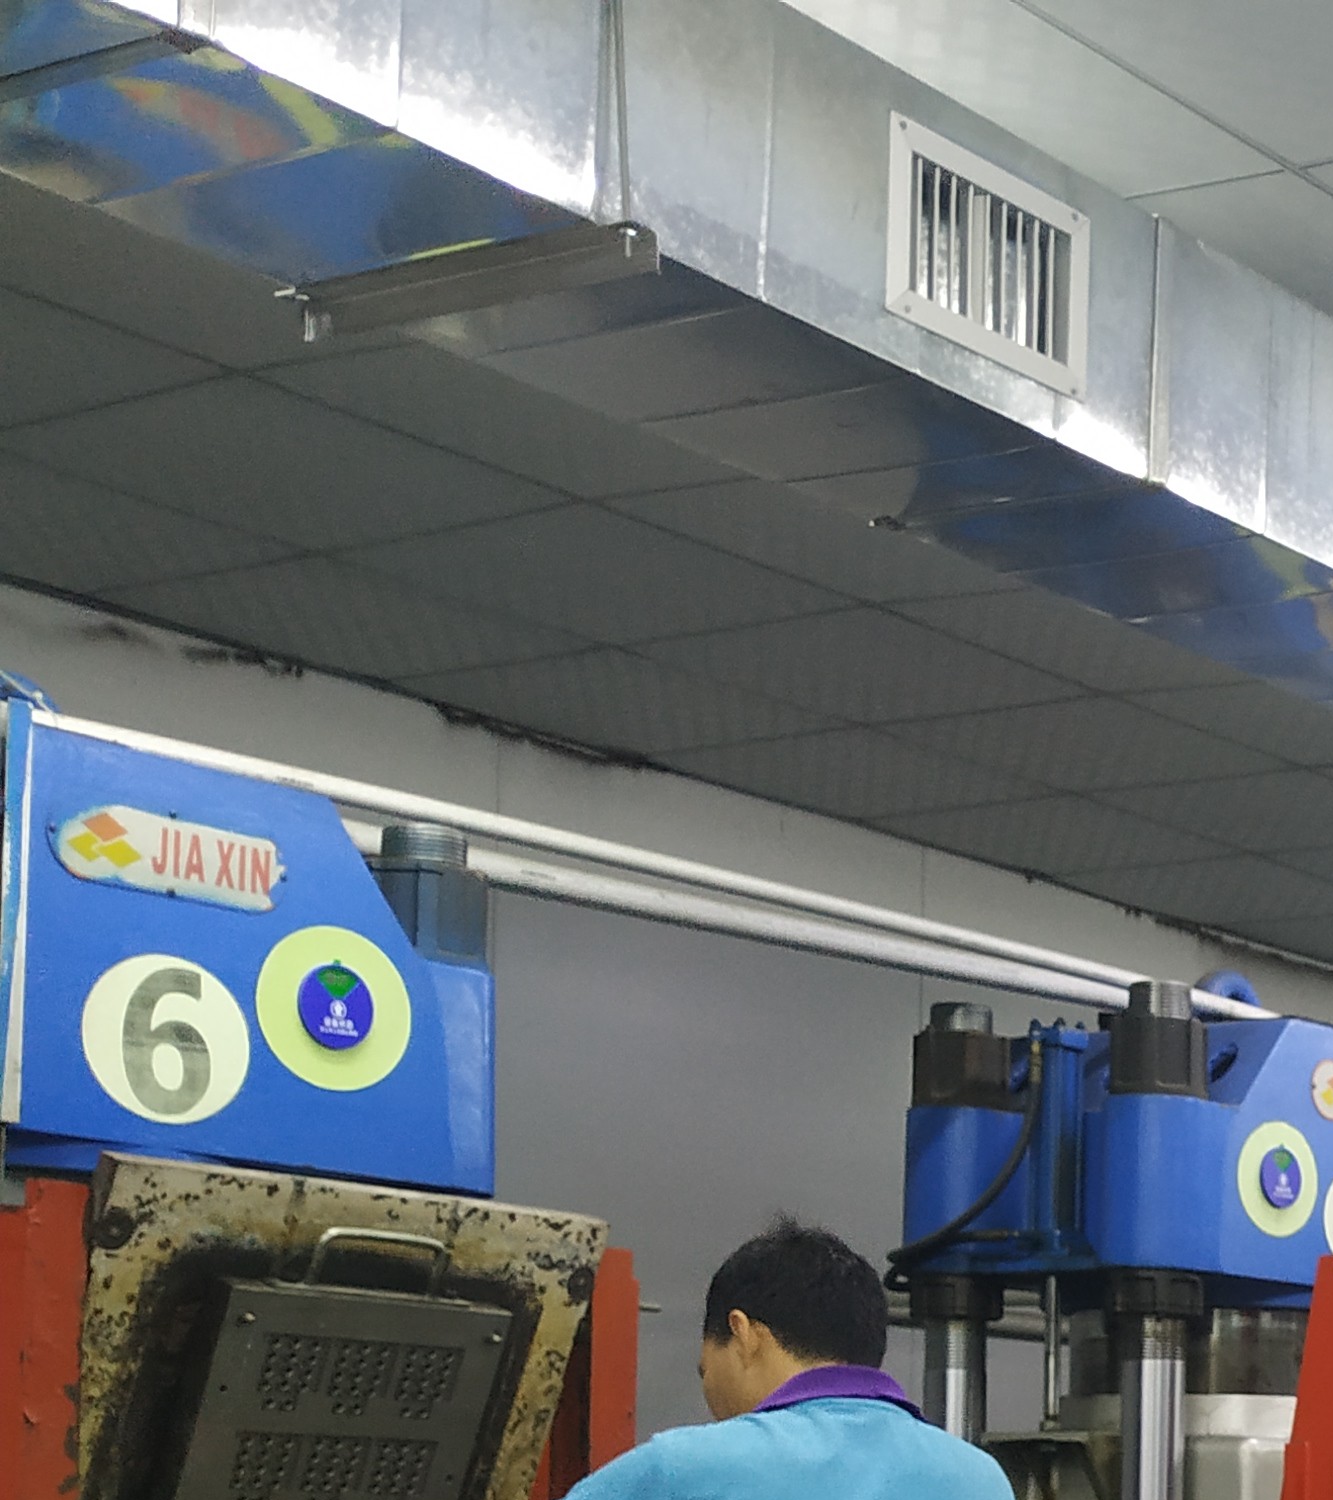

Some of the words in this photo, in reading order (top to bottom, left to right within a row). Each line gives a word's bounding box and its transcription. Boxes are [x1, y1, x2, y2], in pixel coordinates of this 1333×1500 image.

[151, 827, 206, 883] JIA
[214, 838, 272, 896] XIN
[121, 966, 212, 1115] 6
